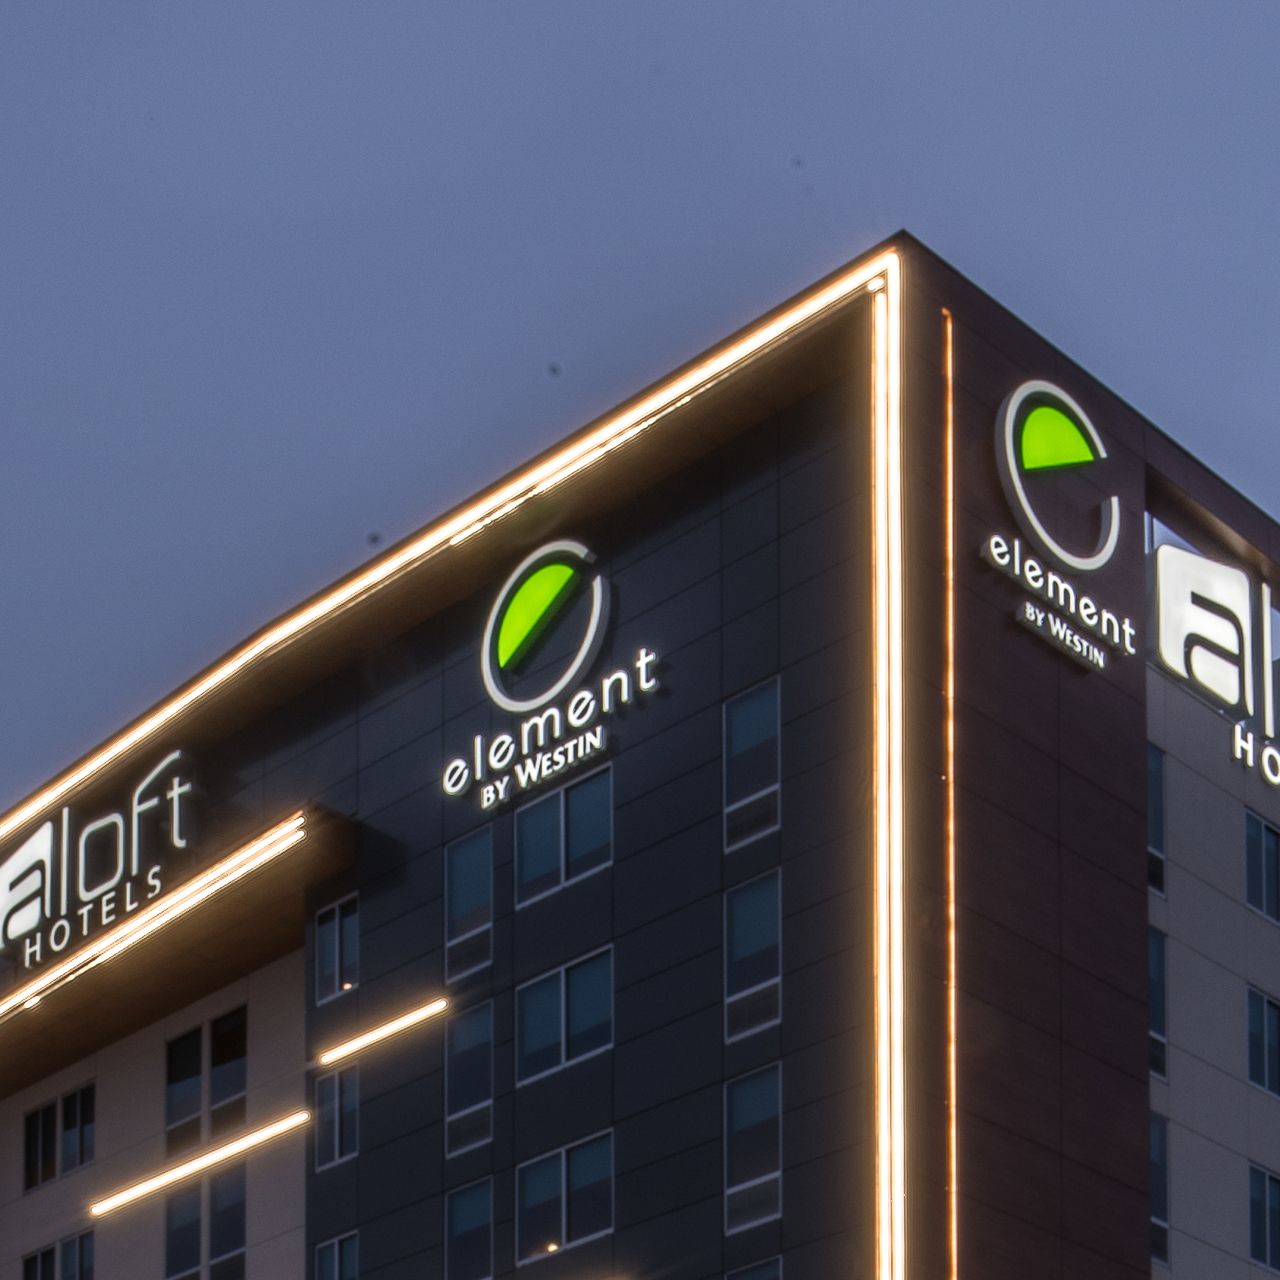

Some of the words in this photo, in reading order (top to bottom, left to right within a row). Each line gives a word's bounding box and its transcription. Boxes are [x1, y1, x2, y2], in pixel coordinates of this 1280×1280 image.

[989, 534, 1137, 656] element
[1024, 601, 1046, 628] BY
[442, 647, 657, 797] element
[480, 775, 511, 811] BY
[24, 864, 162, 969] HOTELS
